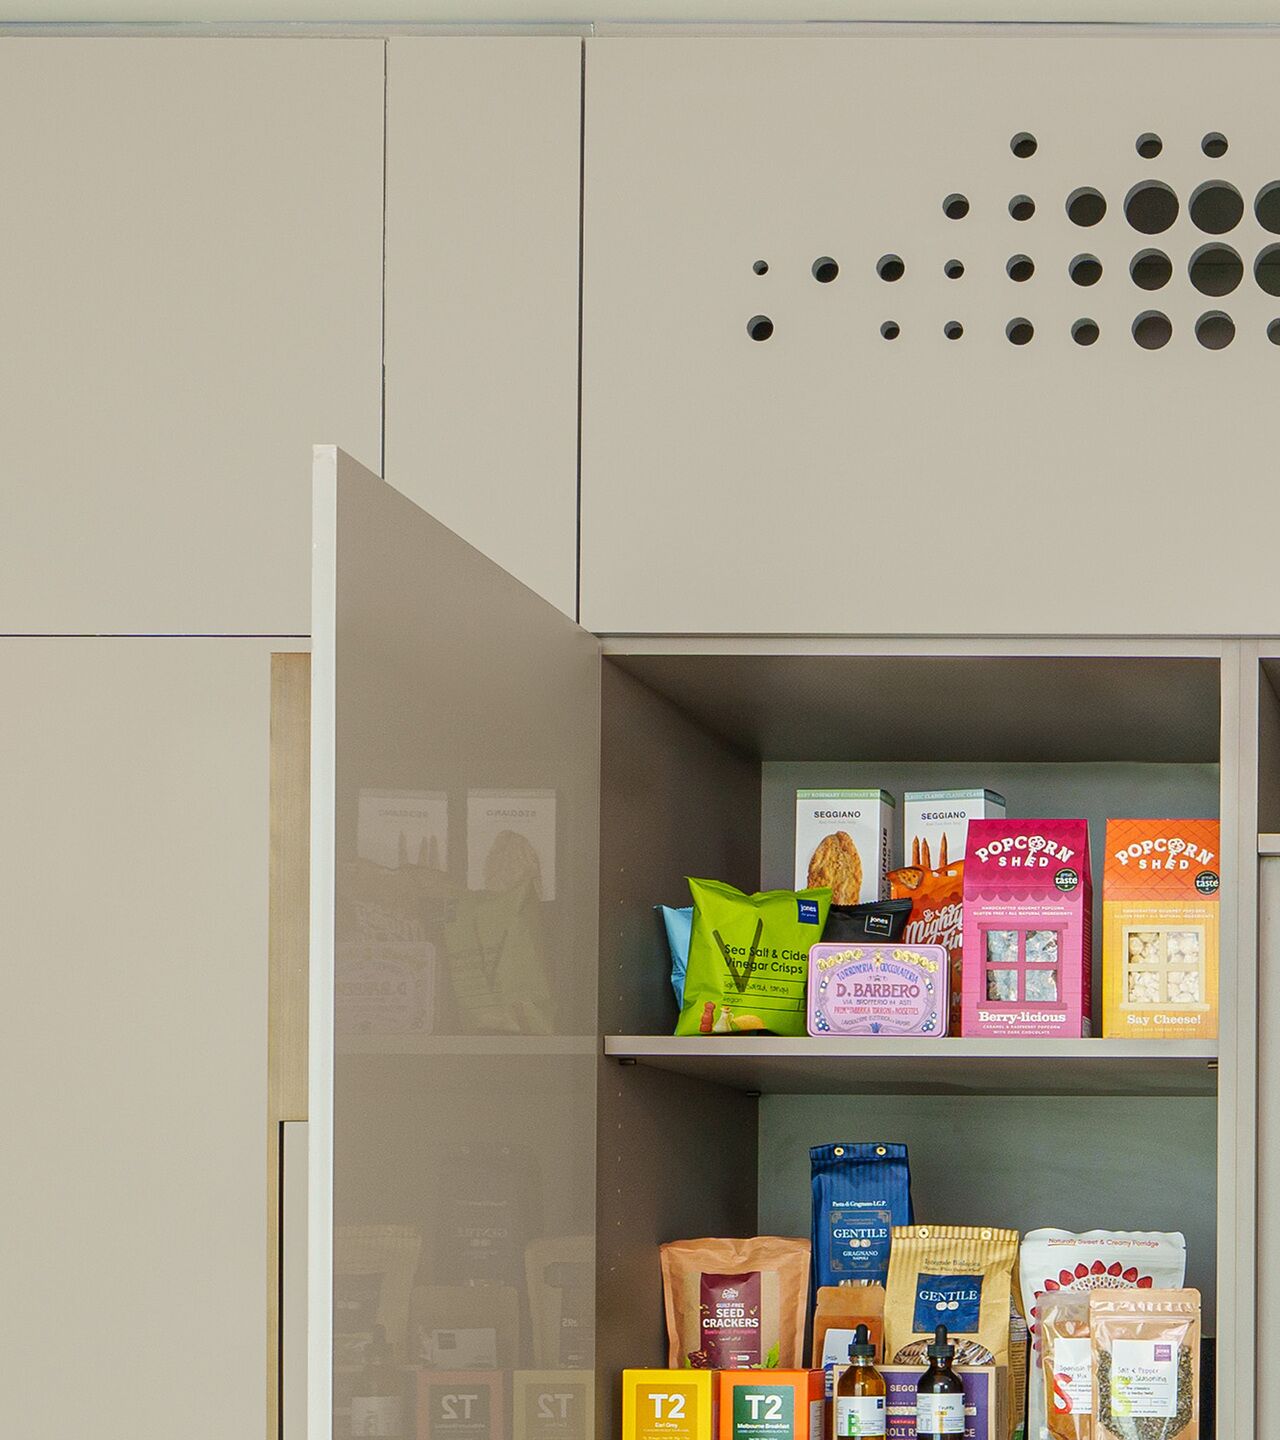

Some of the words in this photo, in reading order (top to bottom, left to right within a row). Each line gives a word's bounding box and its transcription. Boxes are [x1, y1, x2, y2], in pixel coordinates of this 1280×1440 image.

[814, 811, 861, 819] SEGGIANO
[921, 811, 966, 820] SEGGIANO
[975, 836, 1075, 863] POPCORN
[1115, 838, 1215, 865] POPCORN
[998, 856, 1049, 867] SHED
[1139, 859, 1190, 870] SHED
[1055, 877, 1078, 885] taste
[1196, 880, 1219, 888] taste
[800, 904, 817, 912] jones
[870, 916, 889, 924] jones
[724, 944, 746, 956] Sea
[750, 946, 769, 958] Salt
[771, 949, 778, 959] &
[782, 950, 807, 961] Cide
[726, 958, 768, 972] Vinegar
[771, 961, 803, 975] Crisps
[836, 983, 851, 998] D.
[853, 983, 920, 998] BARBERO
[979, 1011, 1066, 1024] Berry-licious
[1127, 1014, 1149, 1027] Say
[1154, 1014, 1201, 1025] Cheese!
[833, 1229, 887, 1239] GENTILE
[1107, 1239, 1131, 1247] Creamy
[1132, 1240, 1159, 1248] Porridge
[920, 1290, 978, 1301] GENTILE
[716, 1308, 744, 1318] SEED
[703, 1318, 759, 1328] CRACKERS
[648, 1393, 685, 1419] T2
[745, 1395, 783, 1420] T2
